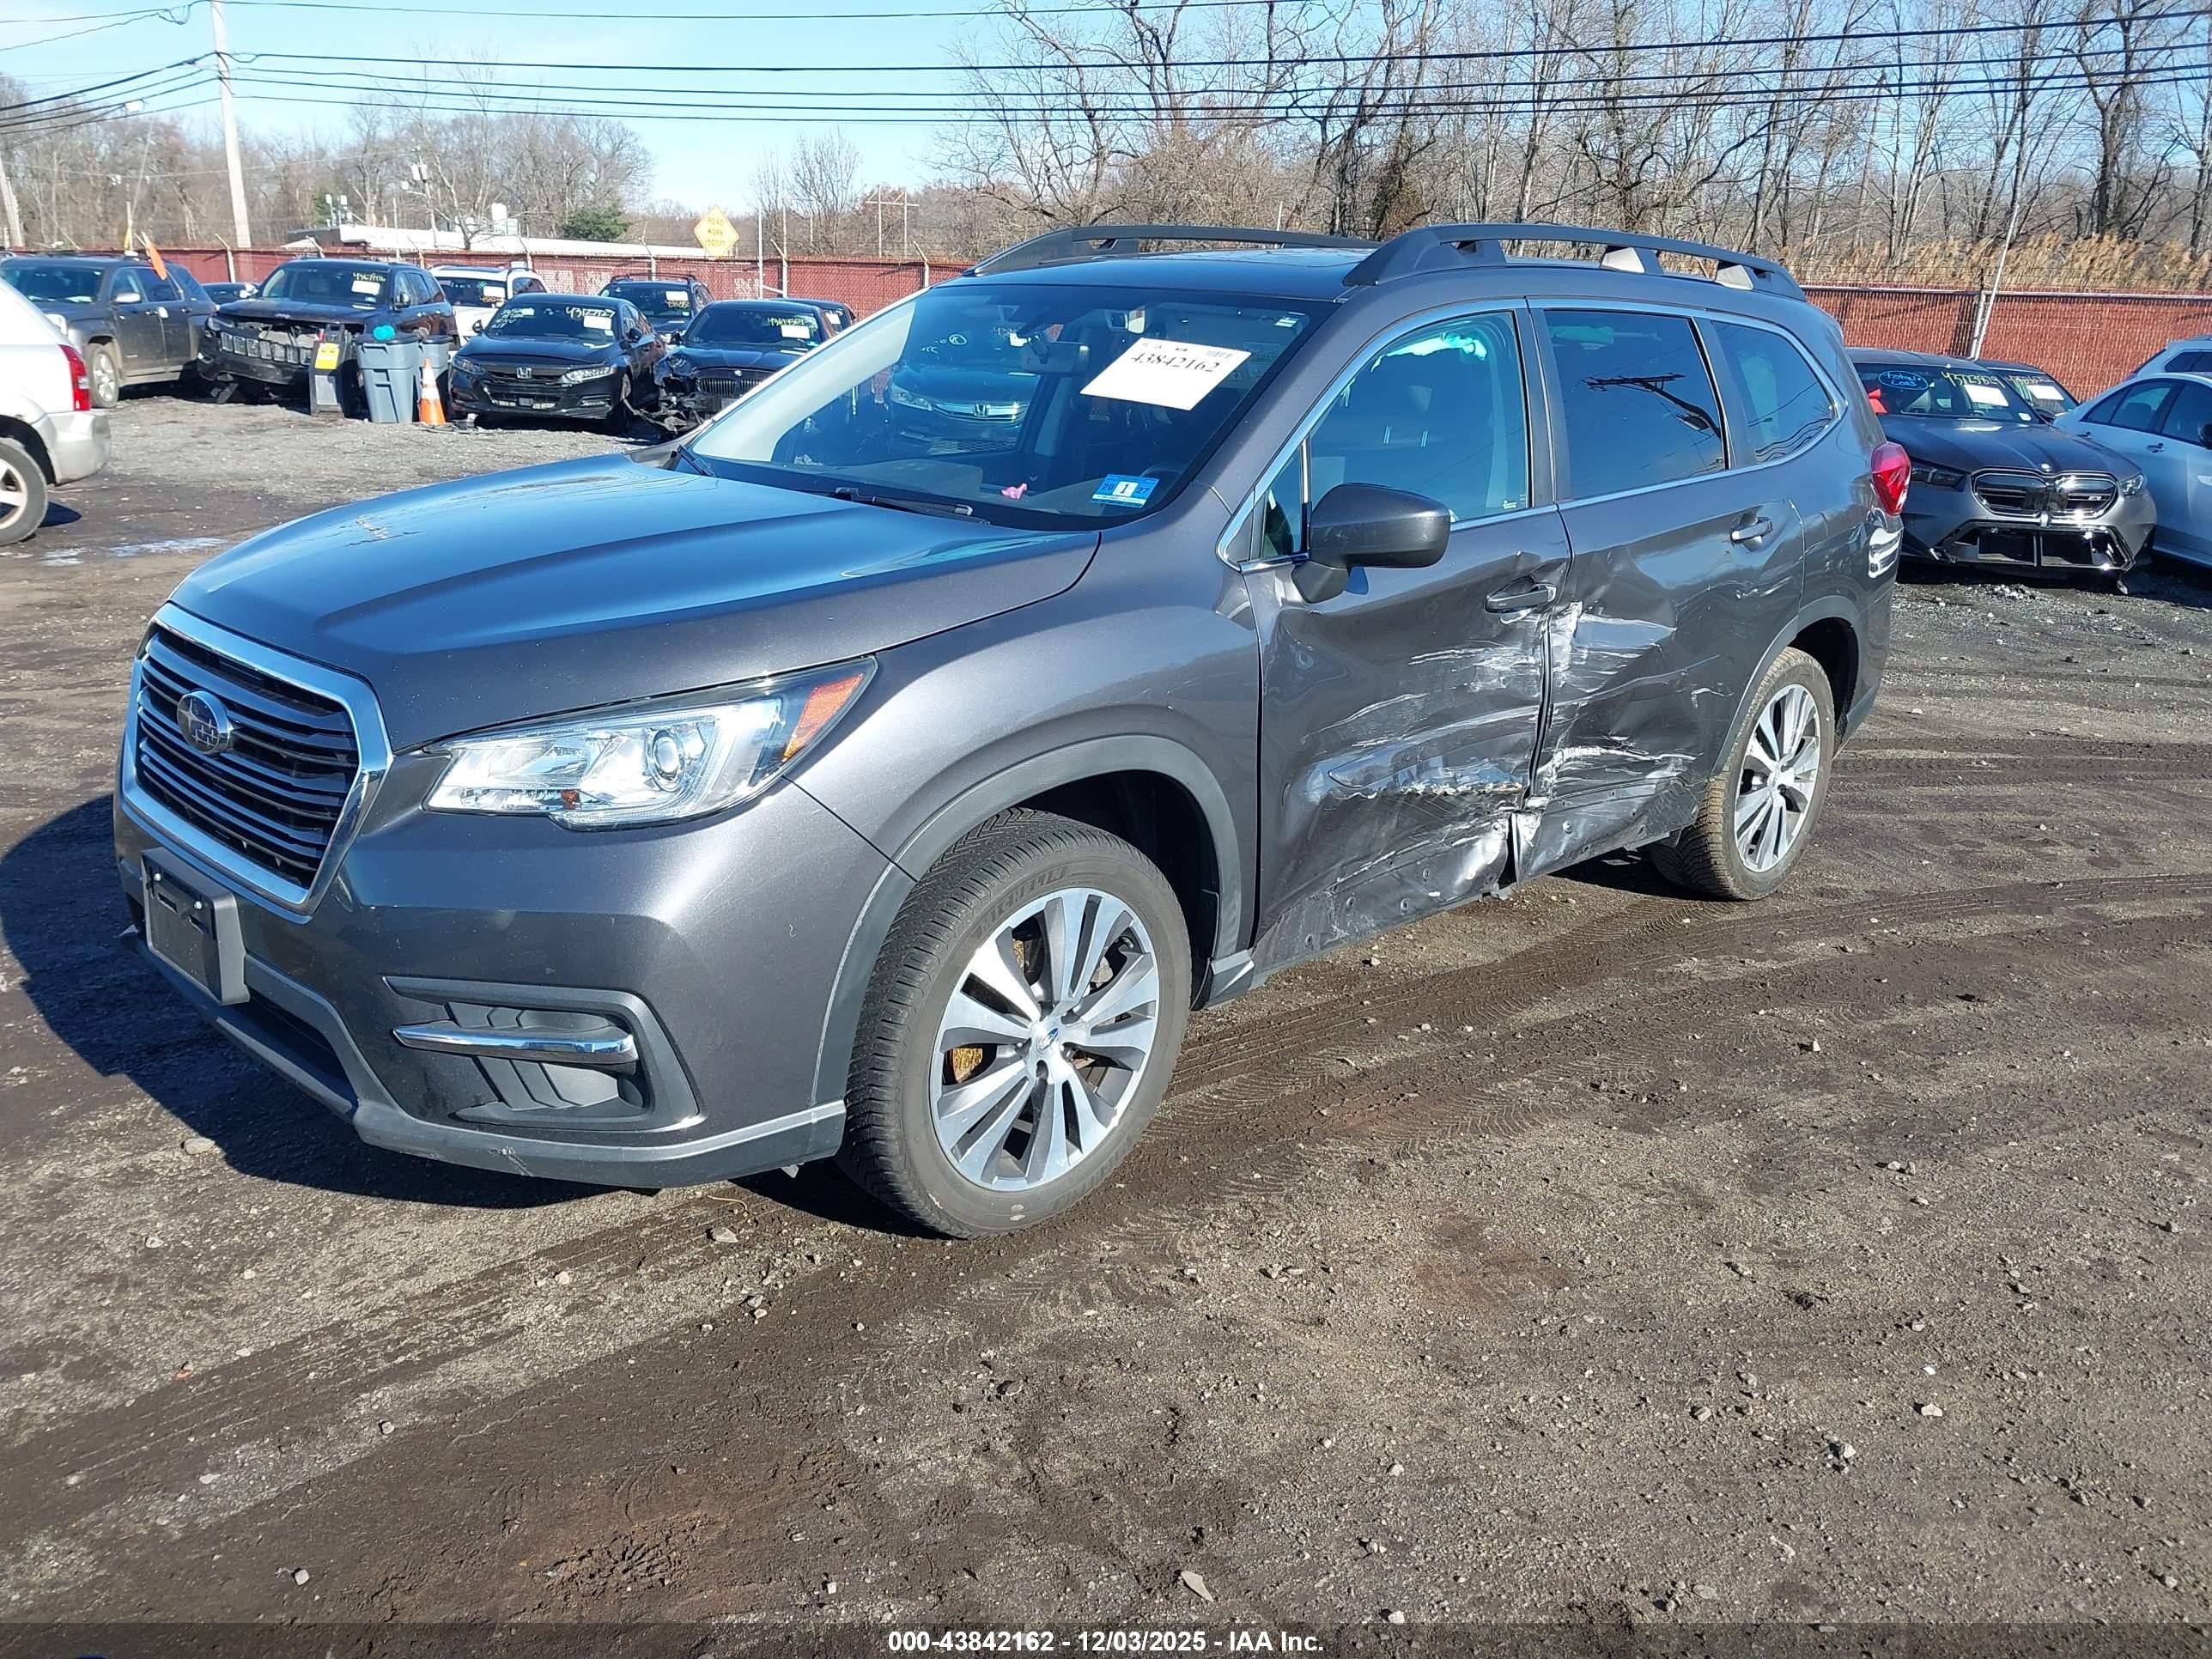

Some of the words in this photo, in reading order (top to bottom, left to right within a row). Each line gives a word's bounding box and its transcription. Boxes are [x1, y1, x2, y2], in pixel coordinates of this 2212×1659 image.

[708, 217, 724, 226] ROAD
[1131, 352, 1220, 372] 43842162
[1120, 483, 1129, 494] 1
